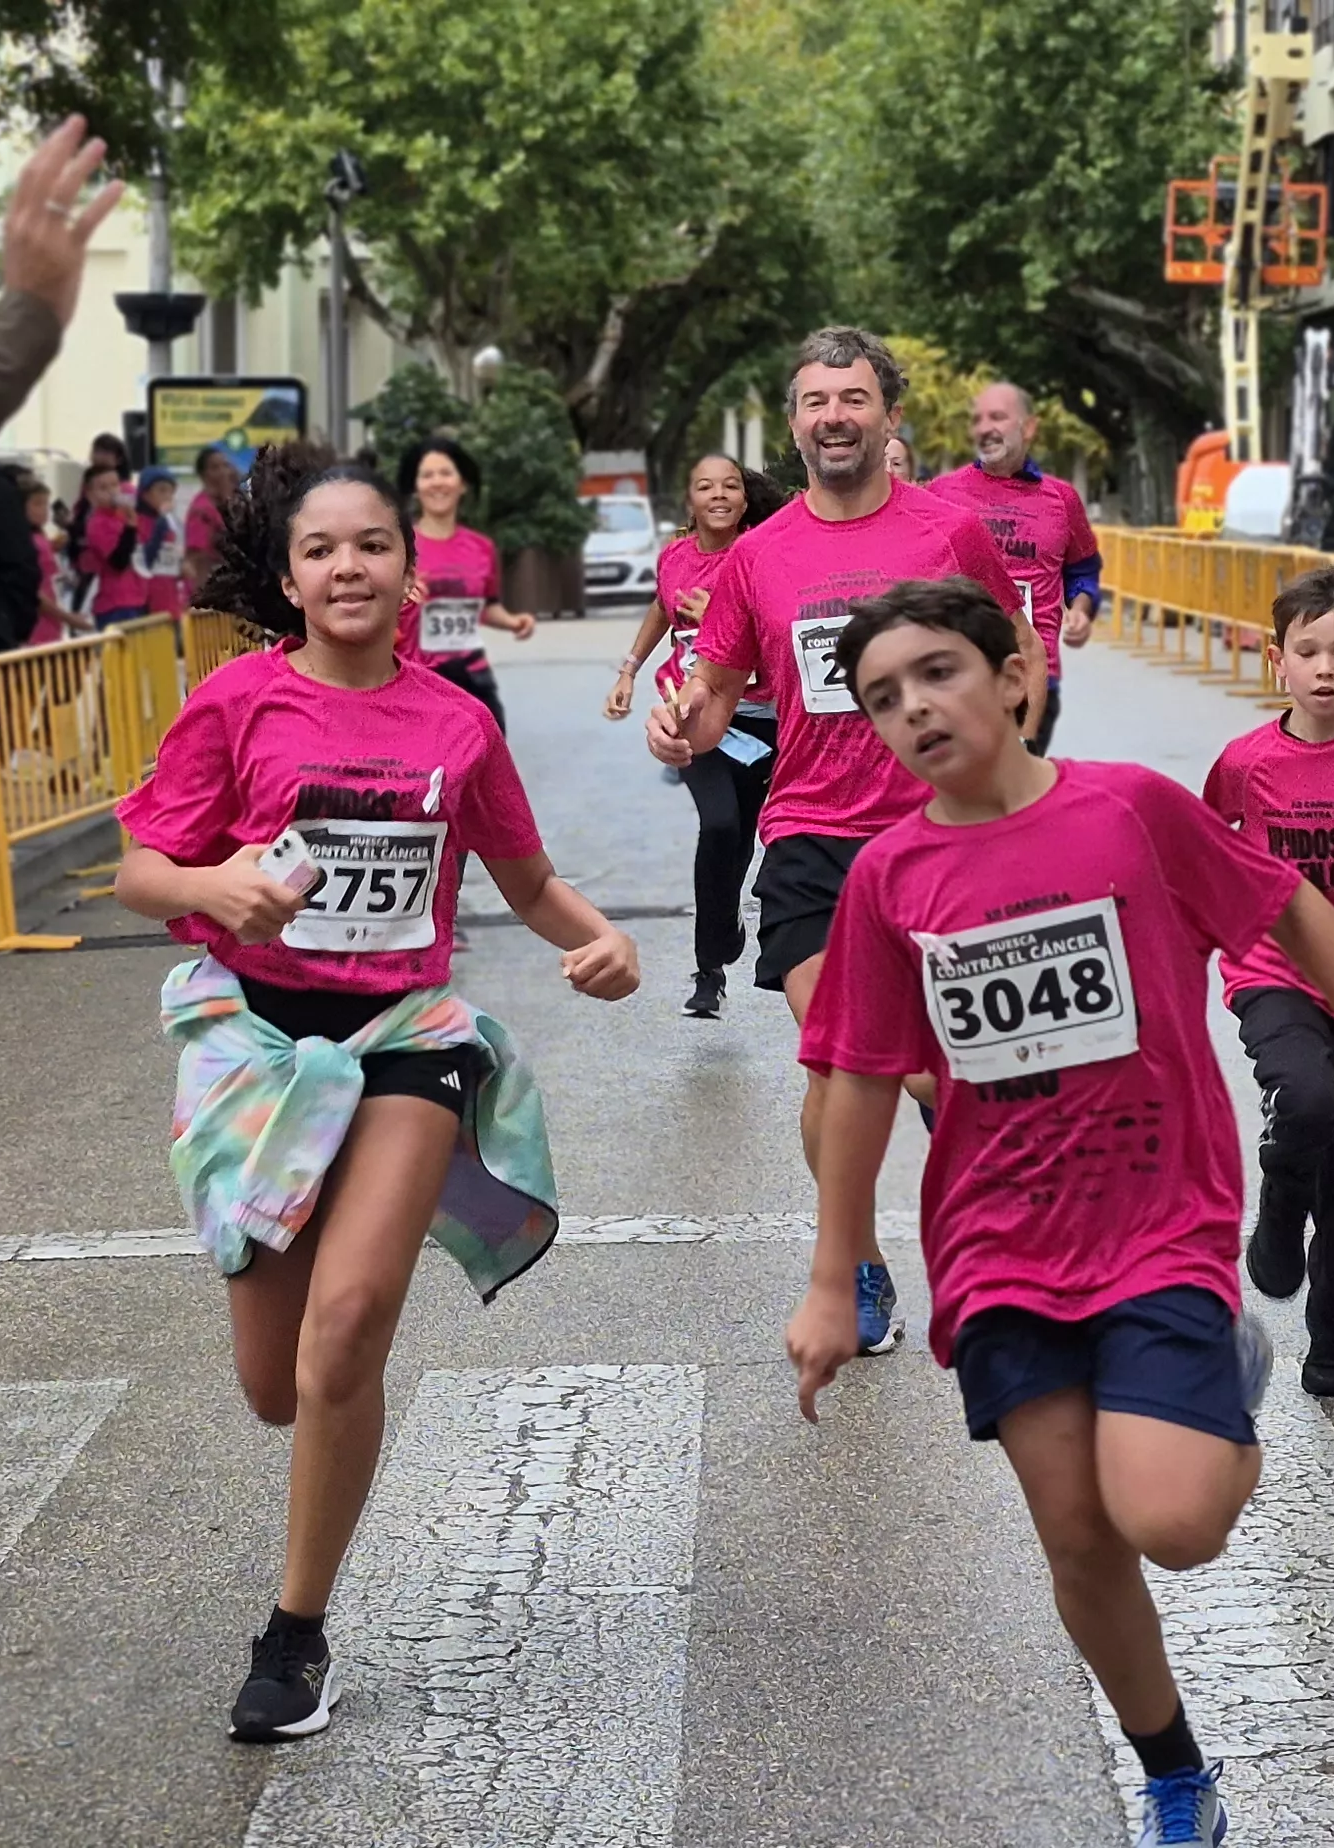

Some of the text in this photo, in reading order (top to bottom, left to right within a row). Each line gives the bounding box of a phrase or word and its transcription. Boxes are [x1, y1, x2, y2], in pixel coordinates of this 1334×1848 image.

[807, 636, 836, 648] CONT
[310, 844, 428, 860] ONTRA EL CÁNCER
[349, 836, 389, 847] HUESCA
[307, 867, 428, 913] 2757
[986, 933, 1038, 954] HUESCA
[936, 932, 1098, 979] CONTRA EL CÁNCER
[940, 957, 1114, 1041] 3048
